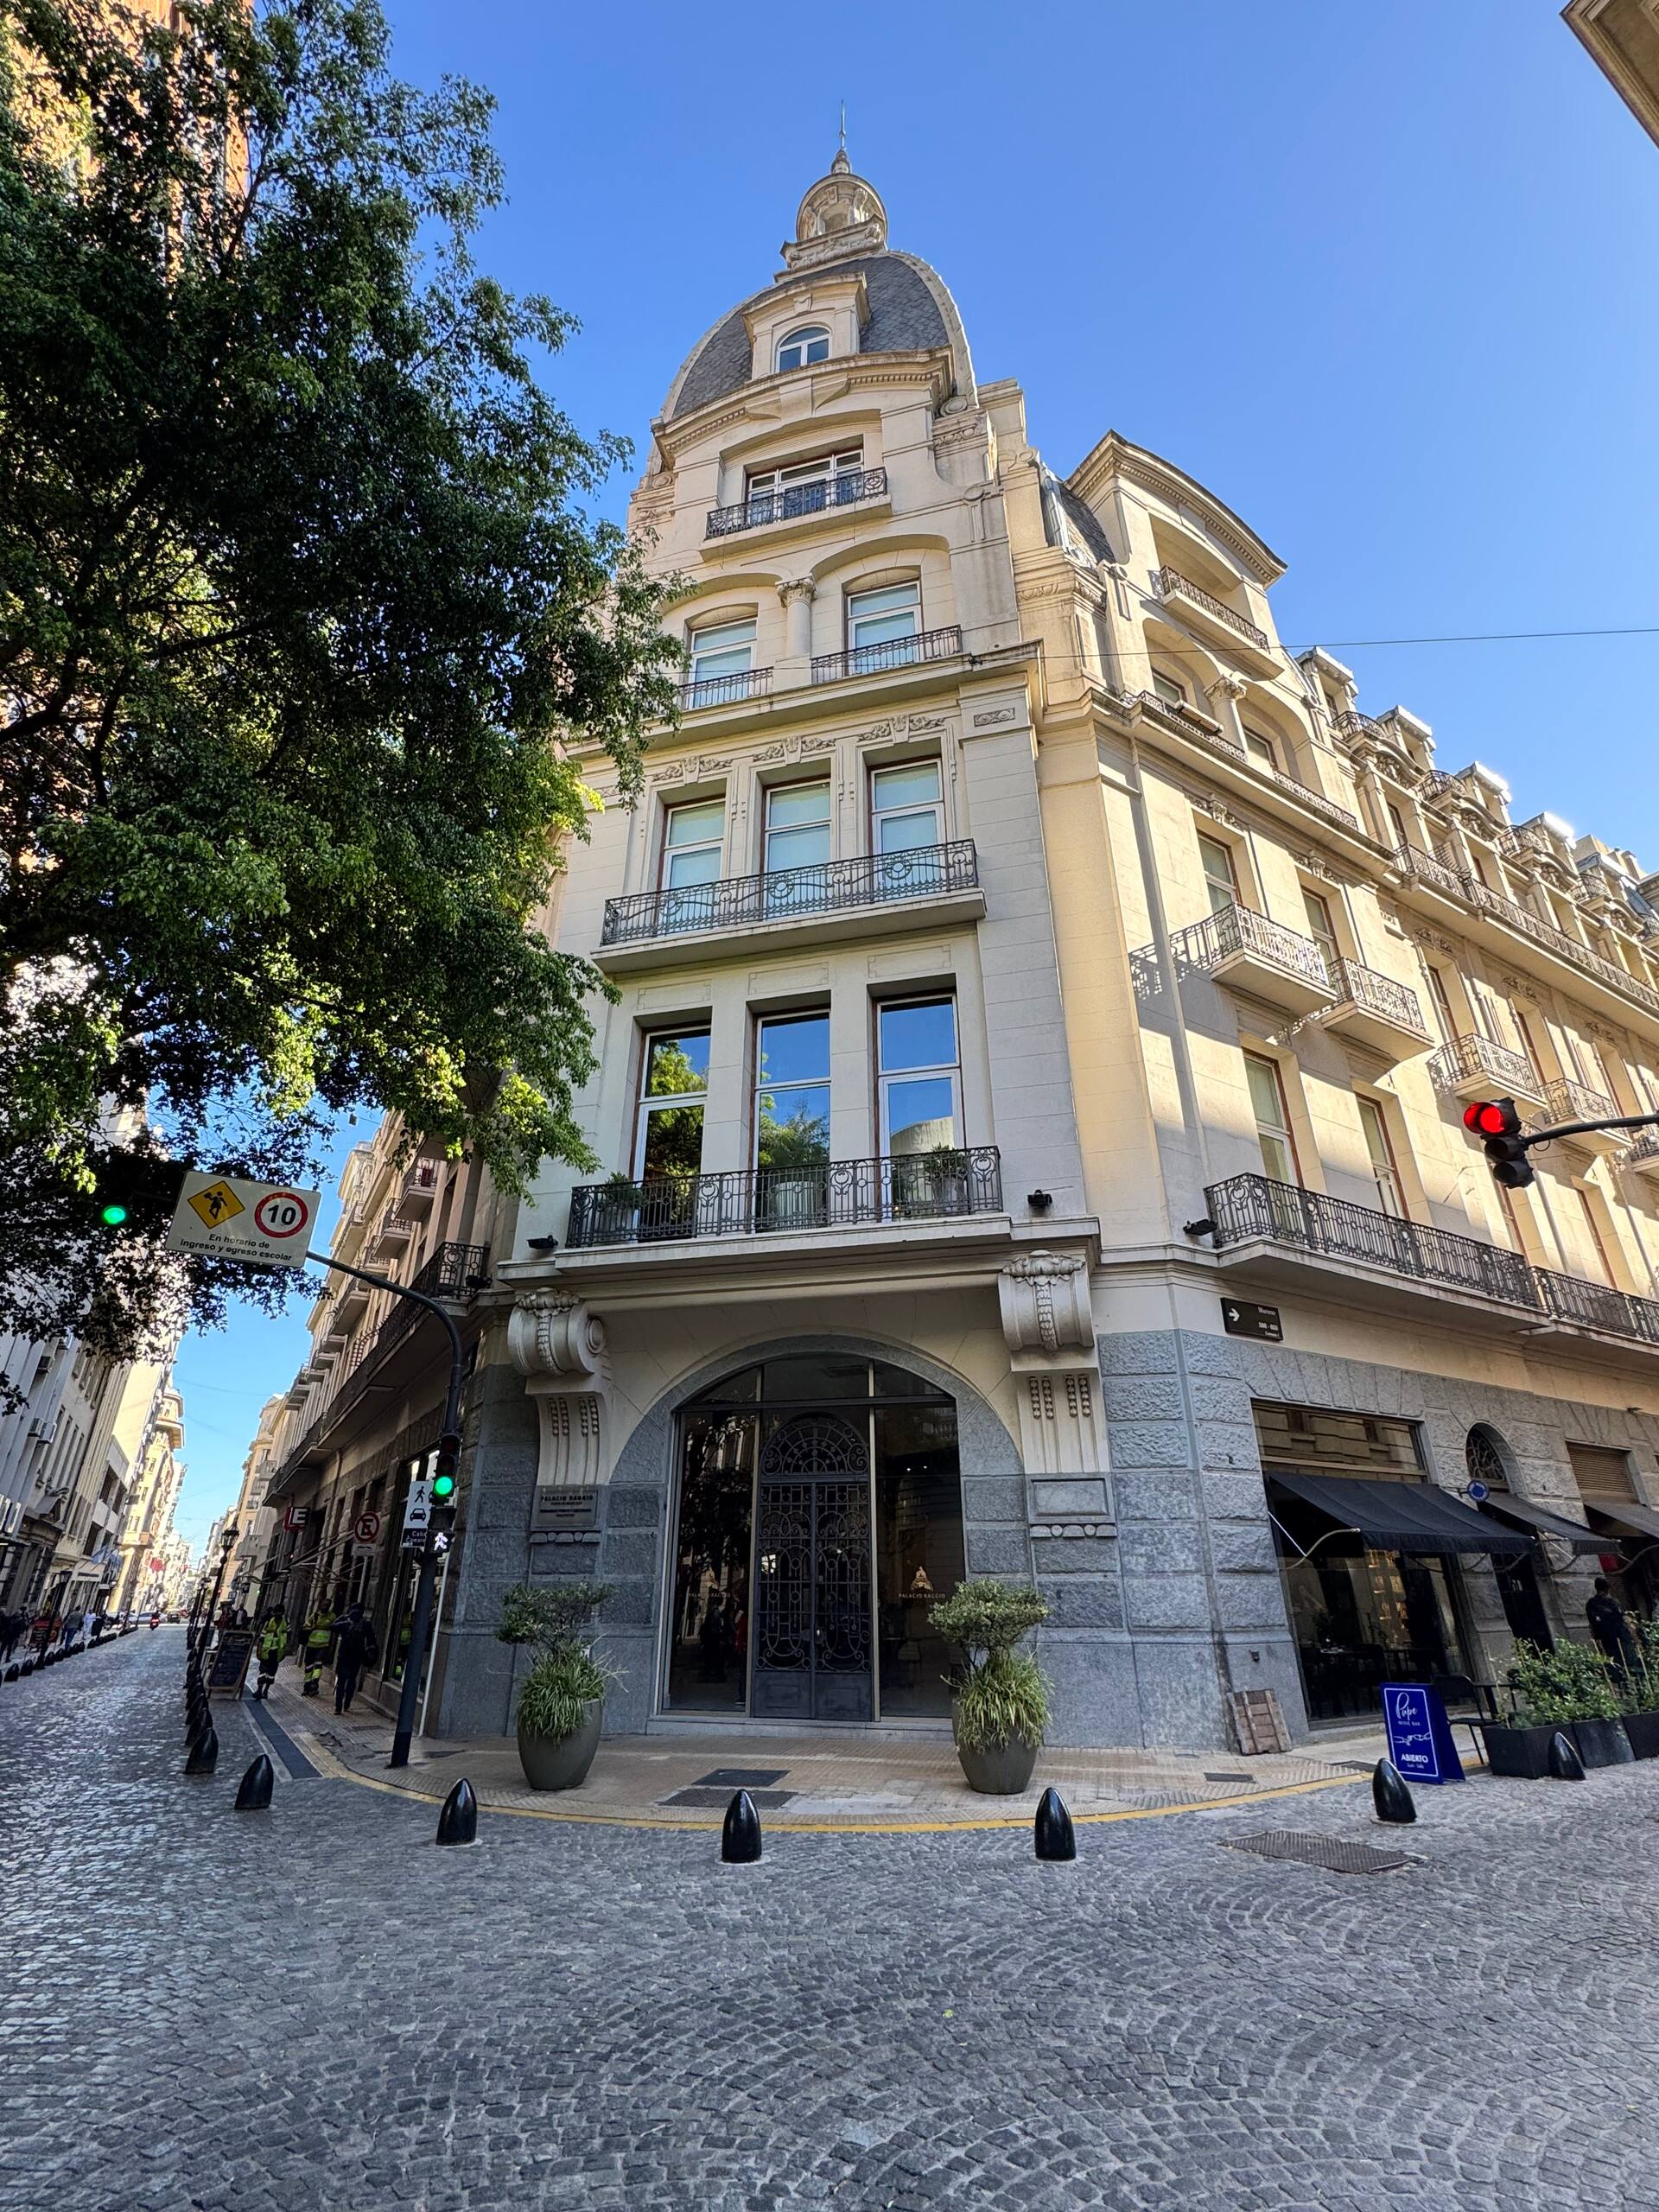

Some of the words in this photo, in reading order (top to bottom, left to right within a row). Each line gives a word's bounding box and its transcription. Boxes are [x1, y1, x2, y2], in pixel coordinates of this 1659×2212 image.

[268, 1205, 296, 1225] 10
[209, 1233, 221, 1242] En
[224, 1236, 257, 1247] horario
[226, 1247, 257, 1256] egreso
[259, 1250, 292, 1262] escolar
[292, 1508, 308, 1524] E
[1402, 1753, 1428, 1763] ABIERTO
